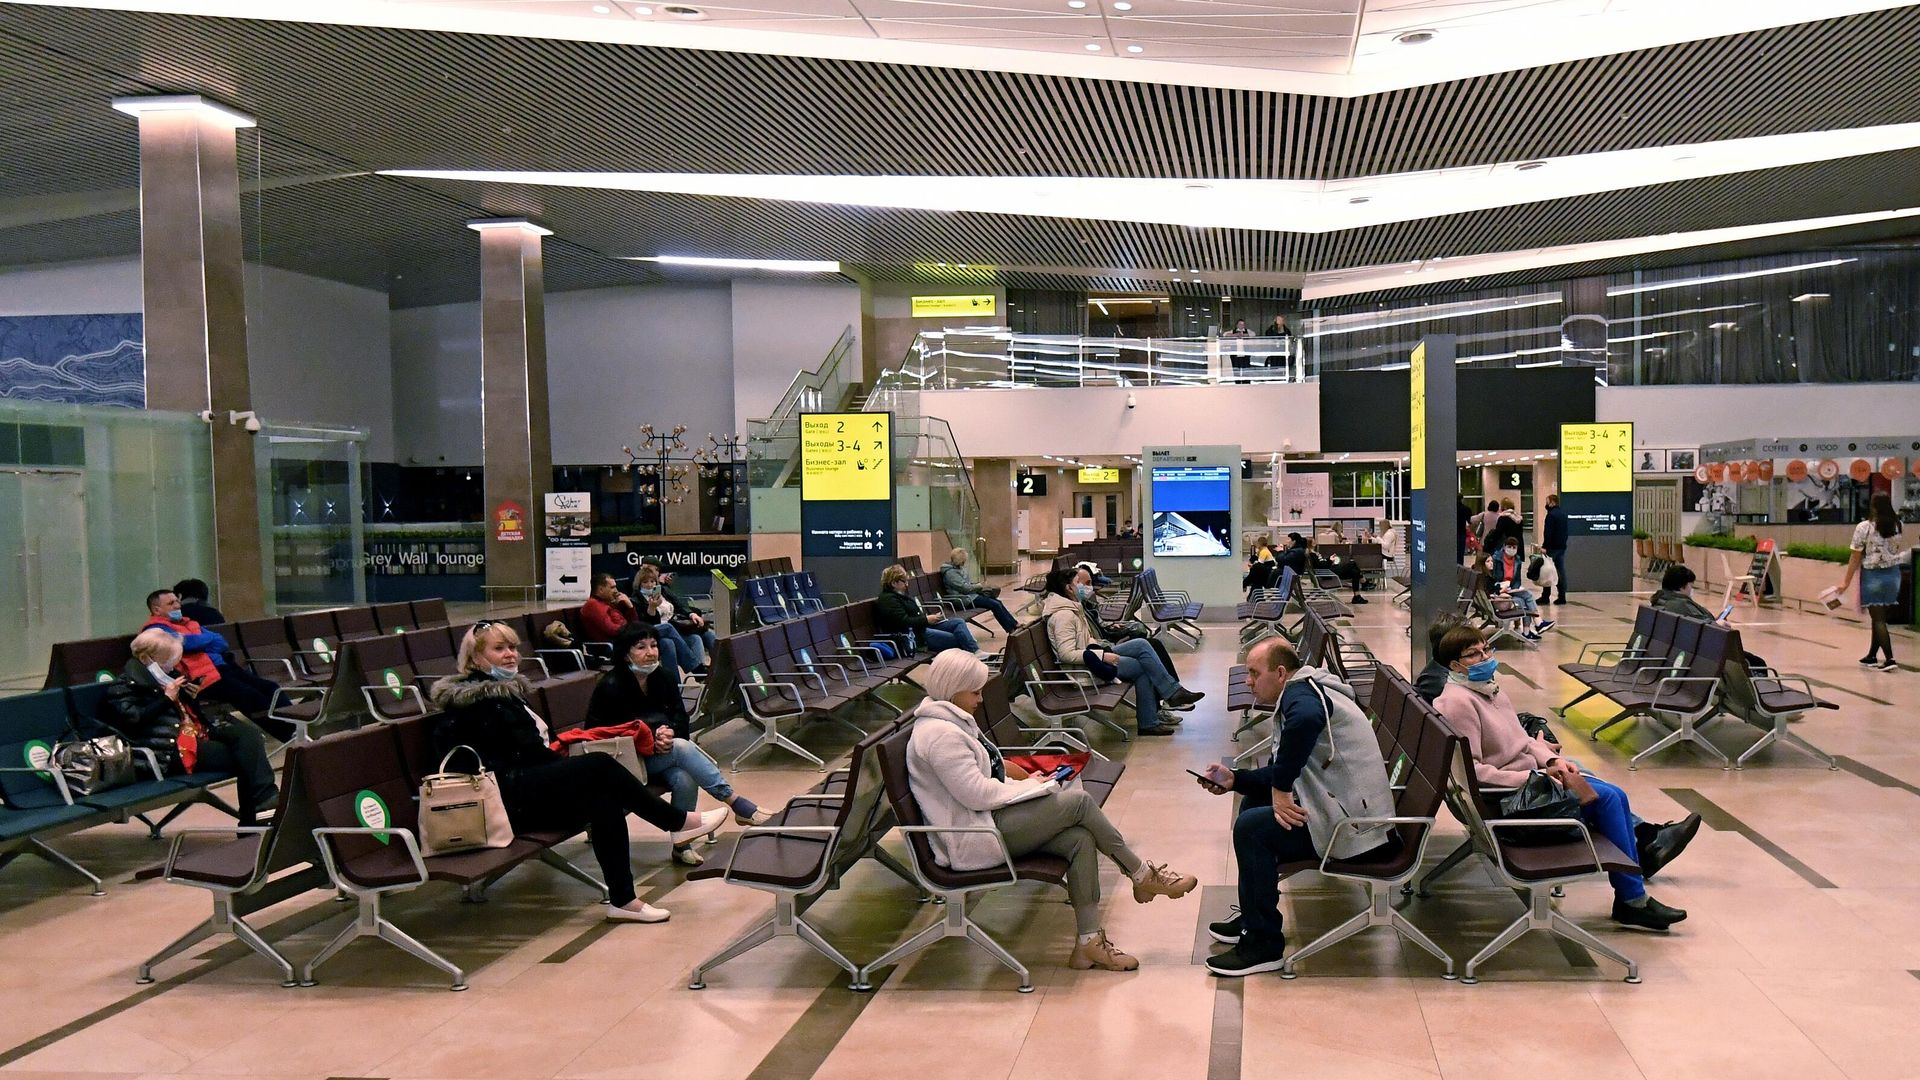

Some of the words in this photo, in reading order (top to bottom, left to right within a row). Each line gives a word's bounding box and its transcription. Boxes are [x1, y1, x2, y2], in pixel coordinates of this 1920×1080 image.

[805, 421, 829, 429] Выход
[837, 421, 845, 433] 2
[1590, 429, 1609, 440] 3-4
[805, 440, 835, 448] Выходы
[837, 439, 861, 452] 3-4
[1590, 444, 1596, 454] 2
[1866, 443, 1901, 451] COGNAC
[805, 458, 847, 466] Бизнес-зал
[1103, 471, 1109, 480] 2
[1510, 472, 1521, 487] 3
[1023, 477, 1034, 494] 2
[399, 551, 429, 565] Wall
[436, 551, 485, 567] lounge
[627, 552, 662, 565] Gry
[667, 552, 697, 565] Wall
[700, 551, 746, 568] lounge
